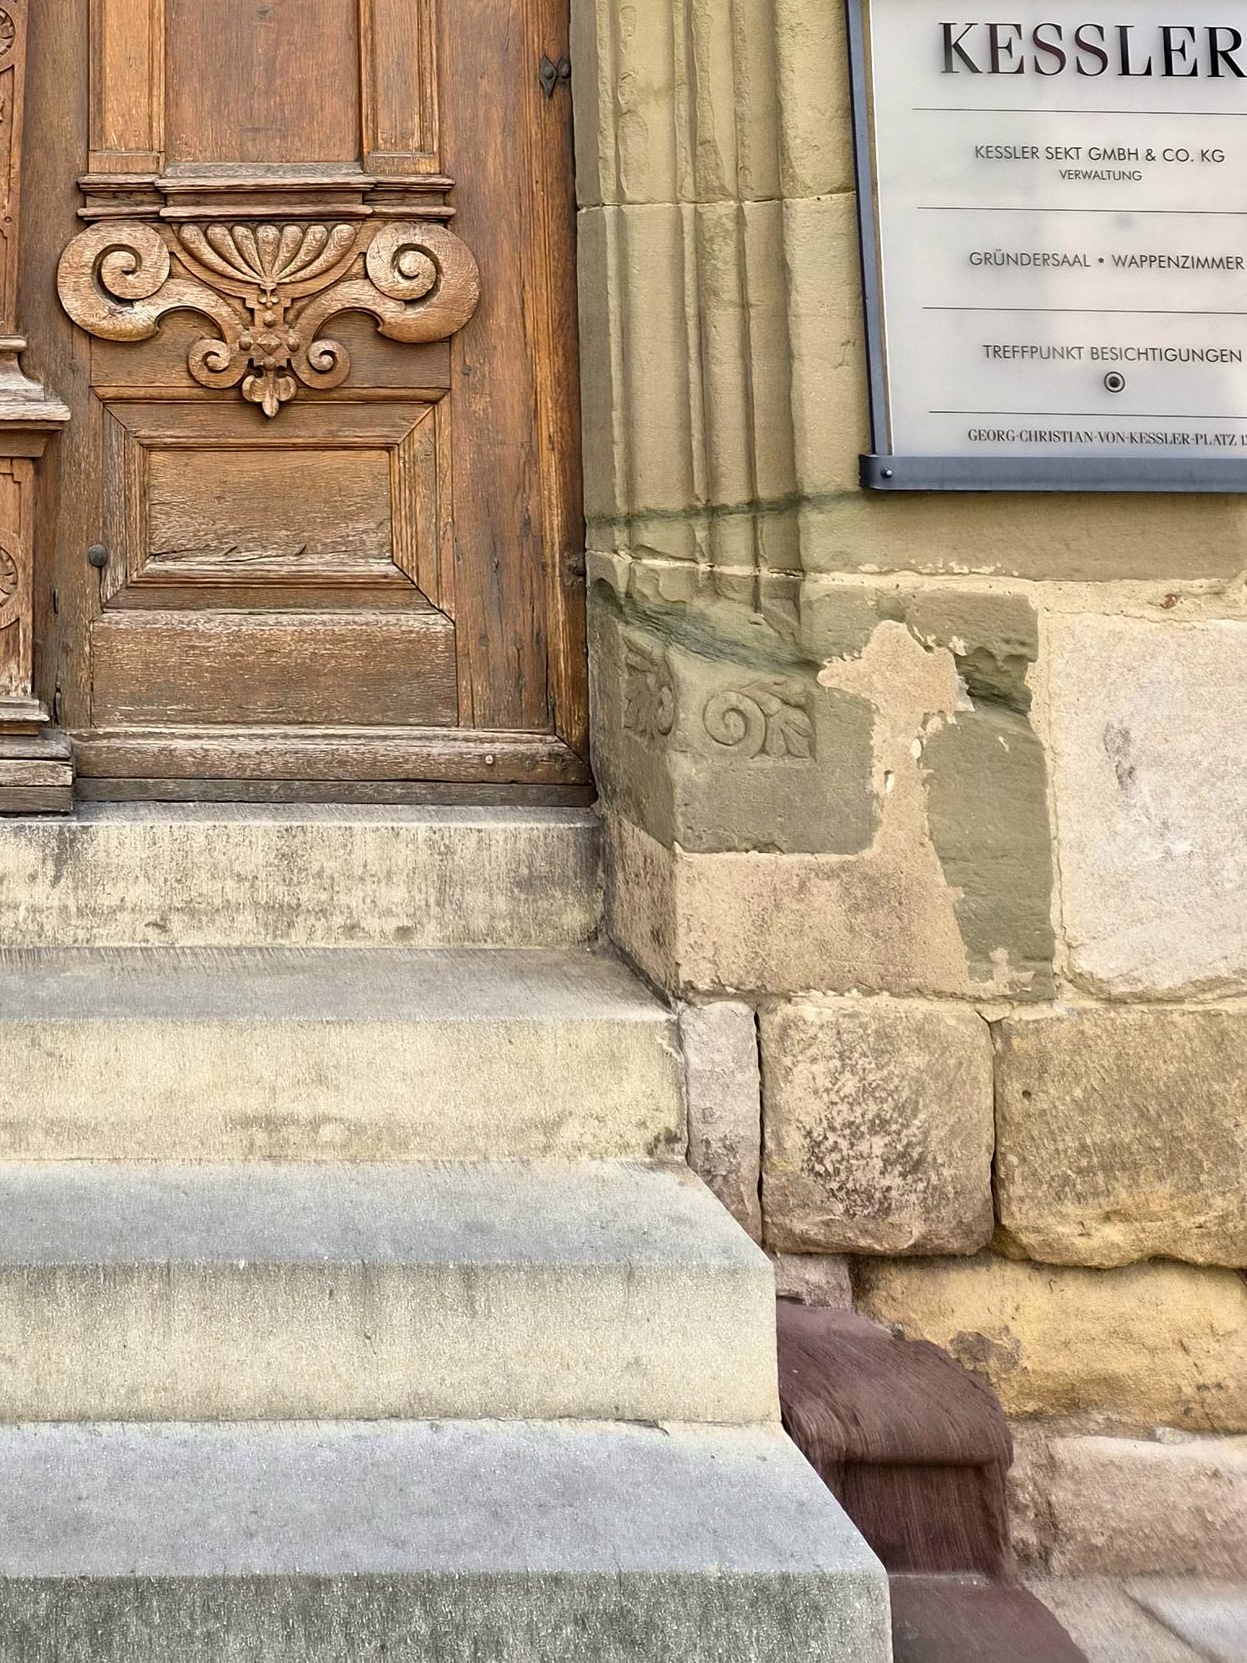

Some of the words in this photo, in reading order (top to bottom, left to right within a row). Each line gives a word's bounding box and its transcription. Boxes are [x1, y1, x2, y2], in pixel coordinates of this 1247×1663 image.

[938, 22, 1247, 78] KESSLER
[975, 145, 1040, 160] KESSLER
[1045, 146, 1082, 161] SEKT
[1088, 147, 1139, 162] GMBH
[1145, 148, 1157, 162] &
[1162, 148, 1194, 163] CO.
[1201, 149, 1225, 163] KG
[1059, 169, 1143, 181] VERWALTUNG
[969, 249, 1091, 268] GRÜNDERSAAL
[1111, 254, 1245, 270] WAPPENZIMMER
[982, 344, 1084, 360] TREFFPUNKT
[1090, 346, 1242, 363] BESICHTIGUNGEN
[968, 428, 1237, 446] GEORG-CHRISTIAN-VON-KESSLER-PLATZ
